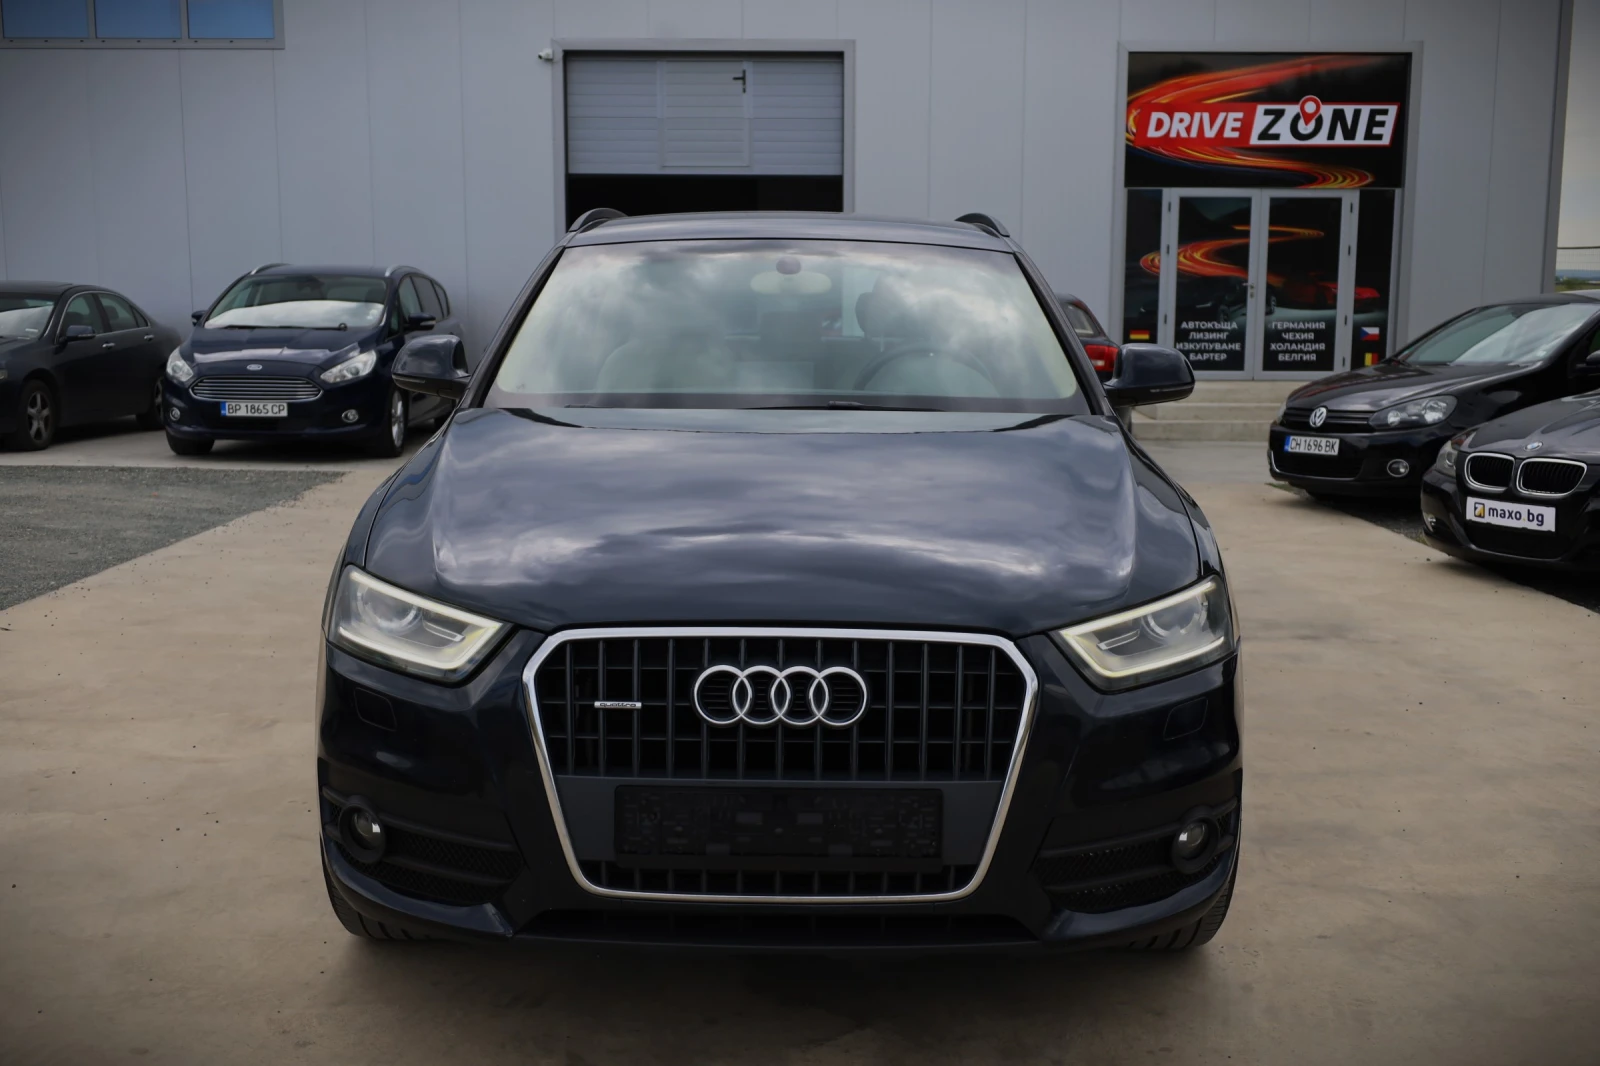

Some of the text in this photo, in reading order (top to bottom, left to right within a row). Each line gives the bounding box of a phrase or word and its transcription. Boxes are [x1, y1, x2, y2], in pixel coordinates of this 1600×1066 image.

[1147, 107, 1389, 141] DRIVE ZONE
[1181, 321, 1238, 330] АВТОКЪЩА
[1272, 321, 1326, 329] ГЕРМАНИЯ
[1189, 331, 1229, 340] ЛИЗИНГ
[1282, 332, 1315, 340] ЧЕХИЯ
[1176, 342, 1242, 351] ИЗКУПУВАНЕ
[1270, 342, 1326, 352] ХОЛАНДИЯ
[1189, 352, 1228, 361] БАРТЕР
[1278, 353, 1317, 361] БЕЛГИЯ
[244, 403, 269, 415] 1865
[1303, 438, 1324, 452] 1696
[1488, 507, 1545, 527] maxo.bg
